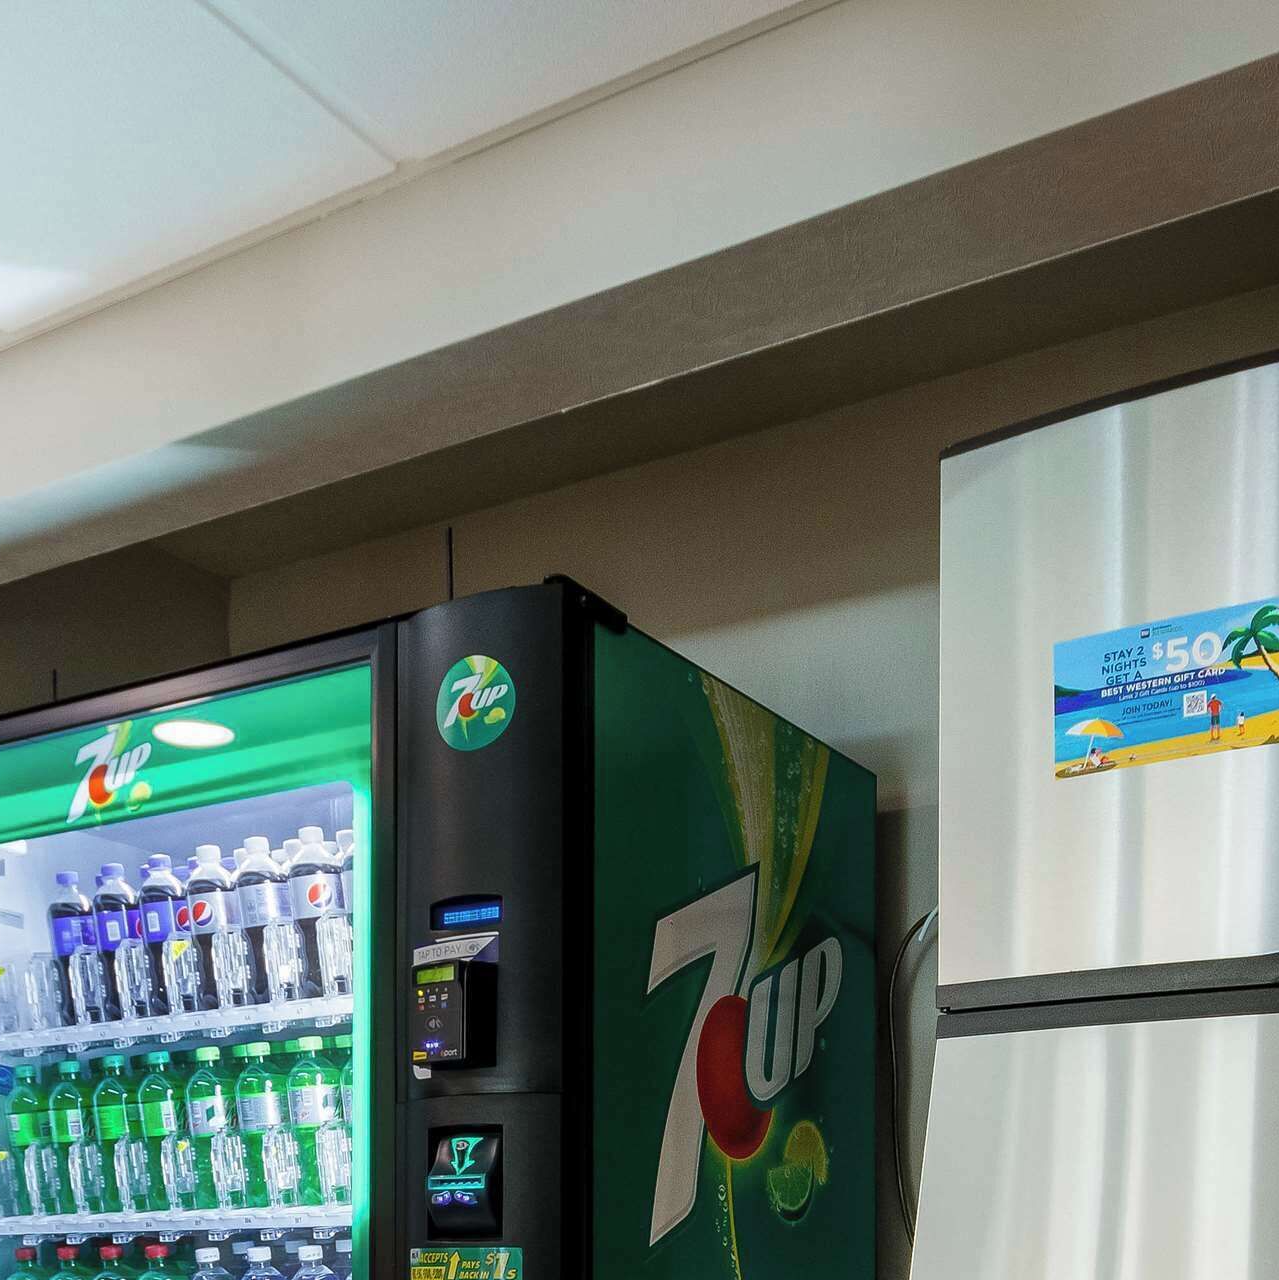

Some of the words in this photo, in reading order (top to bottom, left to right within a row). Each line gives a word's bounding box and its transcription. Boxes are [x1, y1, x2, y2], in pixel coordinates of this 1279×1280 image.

[1104, 648, 1134, 663] STAY
[1137, 646, 1145, 656] 2
[1152, 631, 1222, 672] $50
[1101, 657, 1147, 675] NIGHTS
[1101, 686, 1125, 698] BEST
[1126, 676, 1171, 694] WESTERN
[1174, 671, 1195, 684] GIFT
[1197, 667, 1226, 679] CARD
[1106, 672, 1131, 686] GET
[1134, 671, 1143, 680] A
[1121, 704, 1141, 716] JOIN
[1142, 699, 1172, 711] TODAY!
[445, 944, 461, 956] PAY
[461, 1261, 480, 1269] PAYS
[459, 1271, 478, 1280] BACK
[480, 1271, 490, 1280] IN
